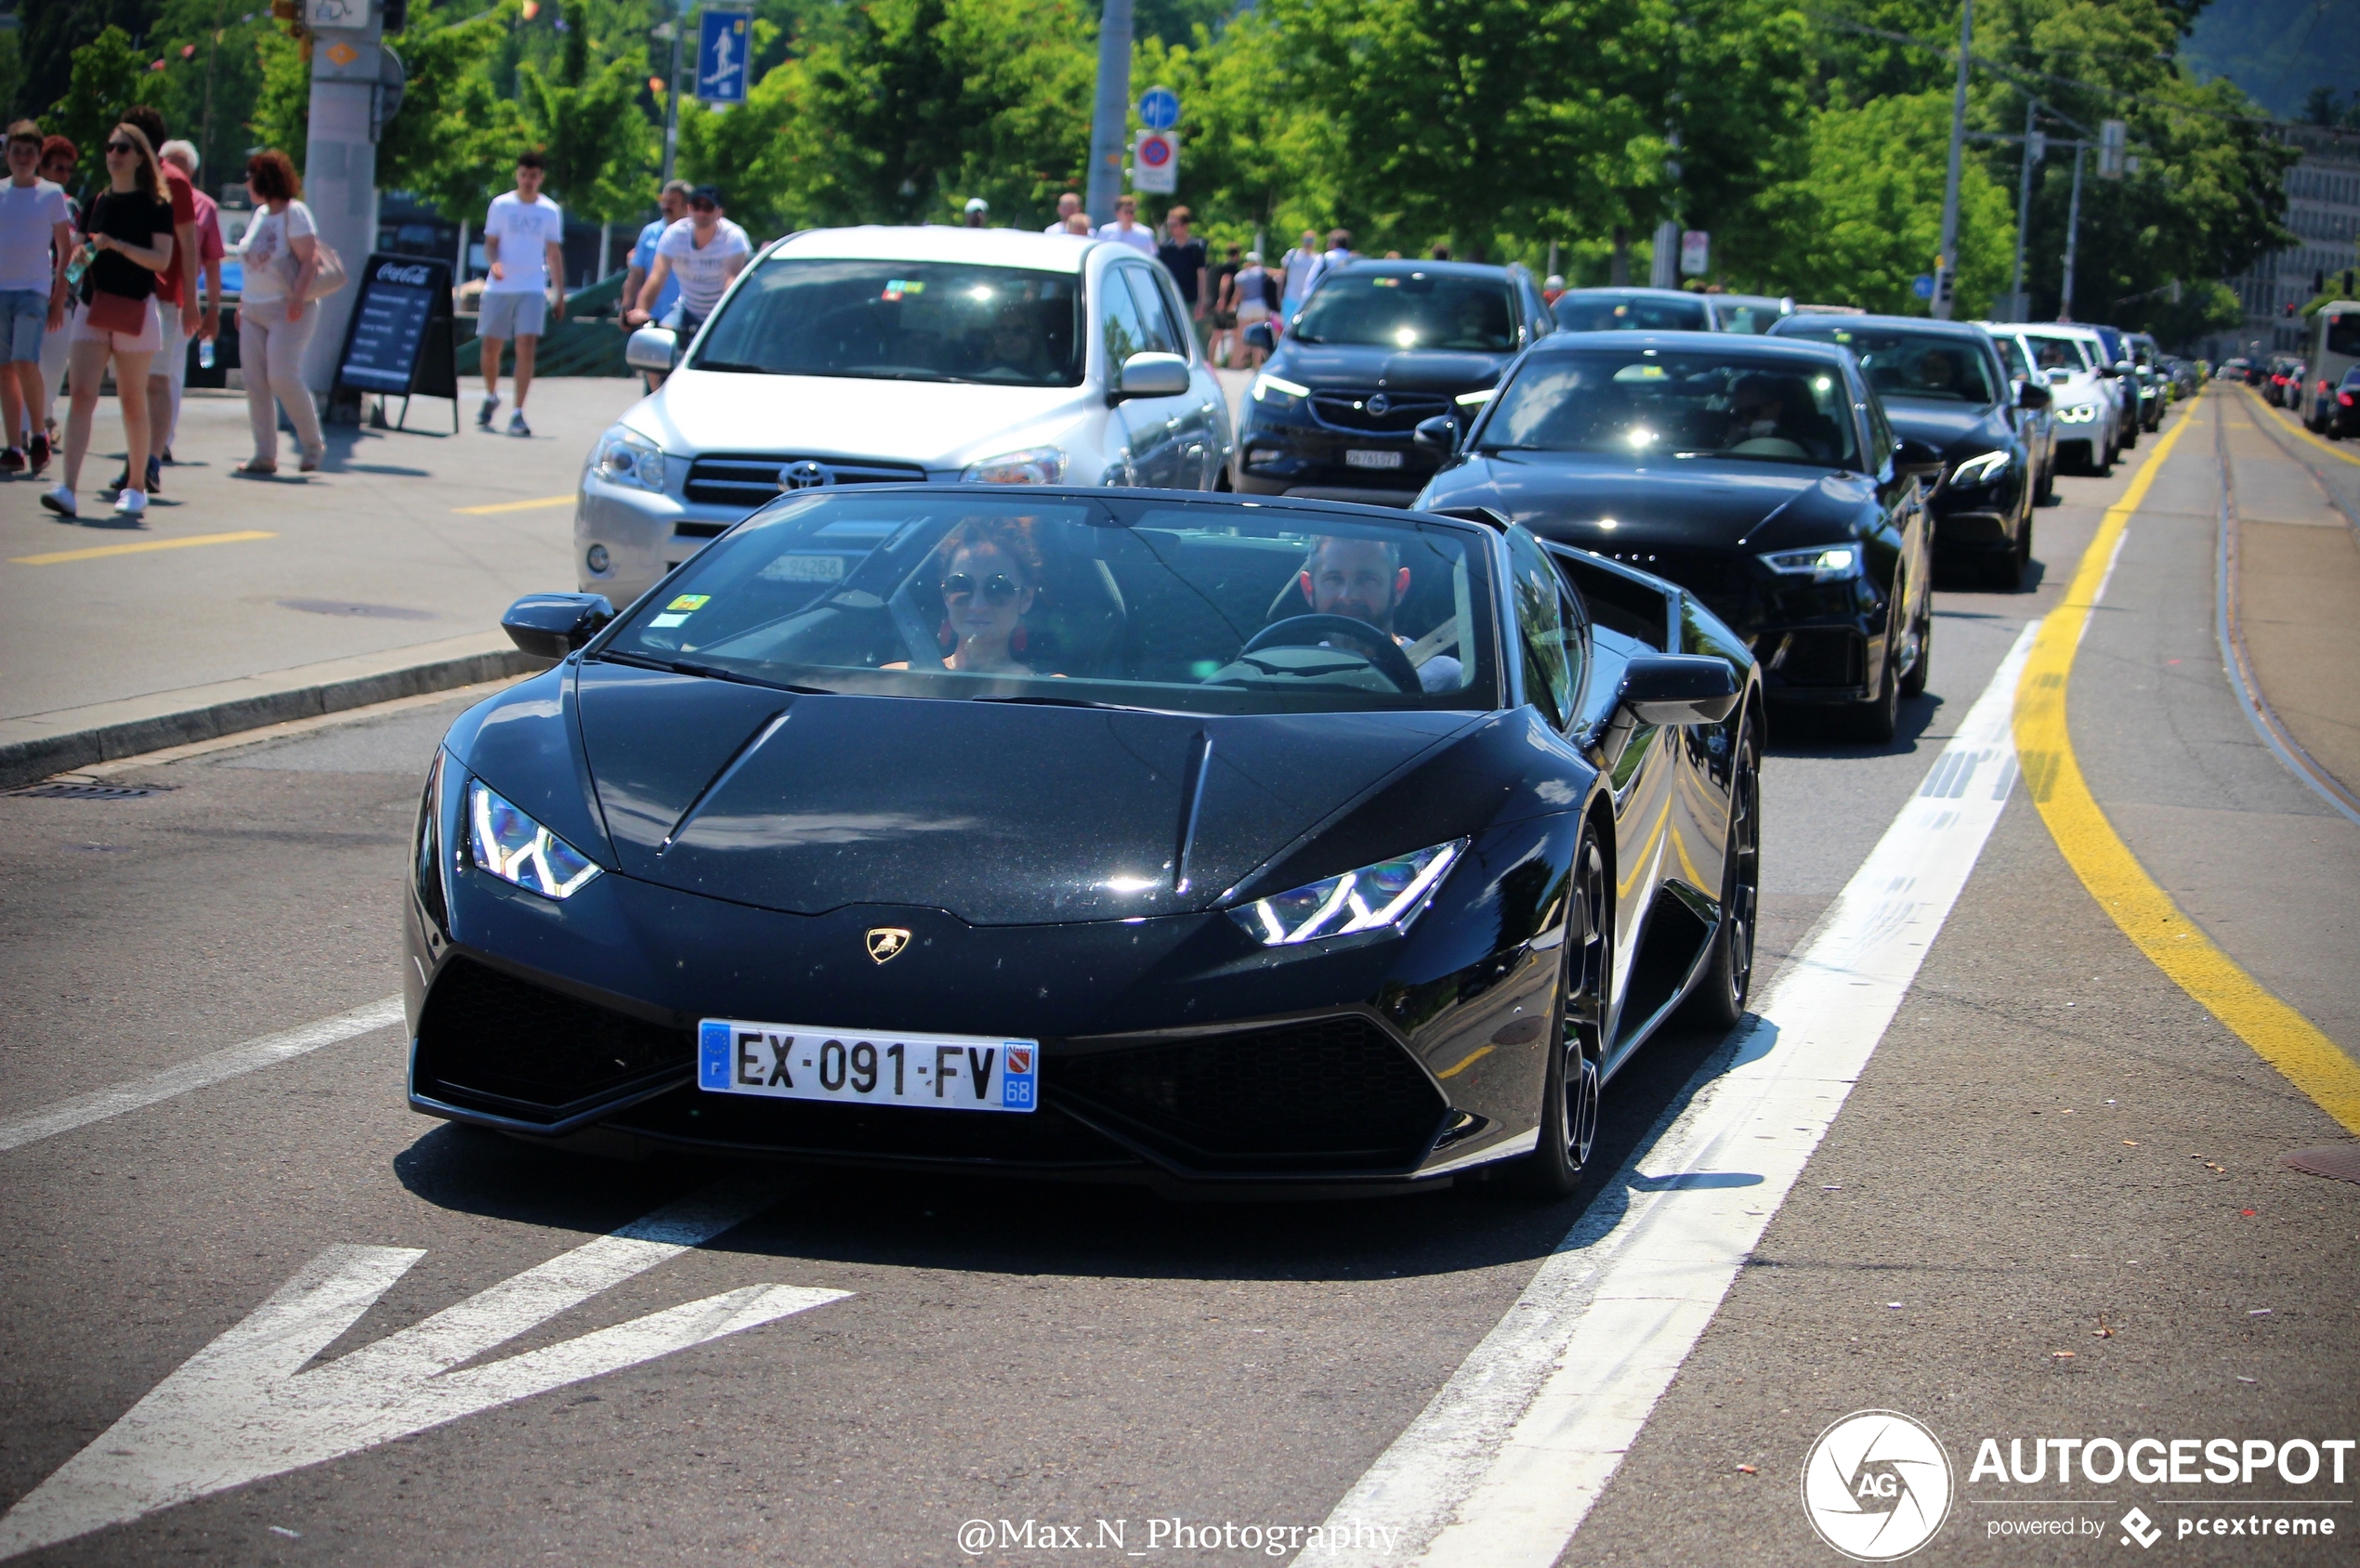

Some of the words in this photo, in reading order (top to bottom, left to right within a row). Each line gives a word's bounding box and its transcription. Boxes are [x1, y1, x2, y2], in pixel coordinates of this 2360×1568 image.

[711, 1062, 721, 1076] F
[738, 1032, 995, 1100] EX-091-FV
[1005, 1080, 1030, 1103] 68
